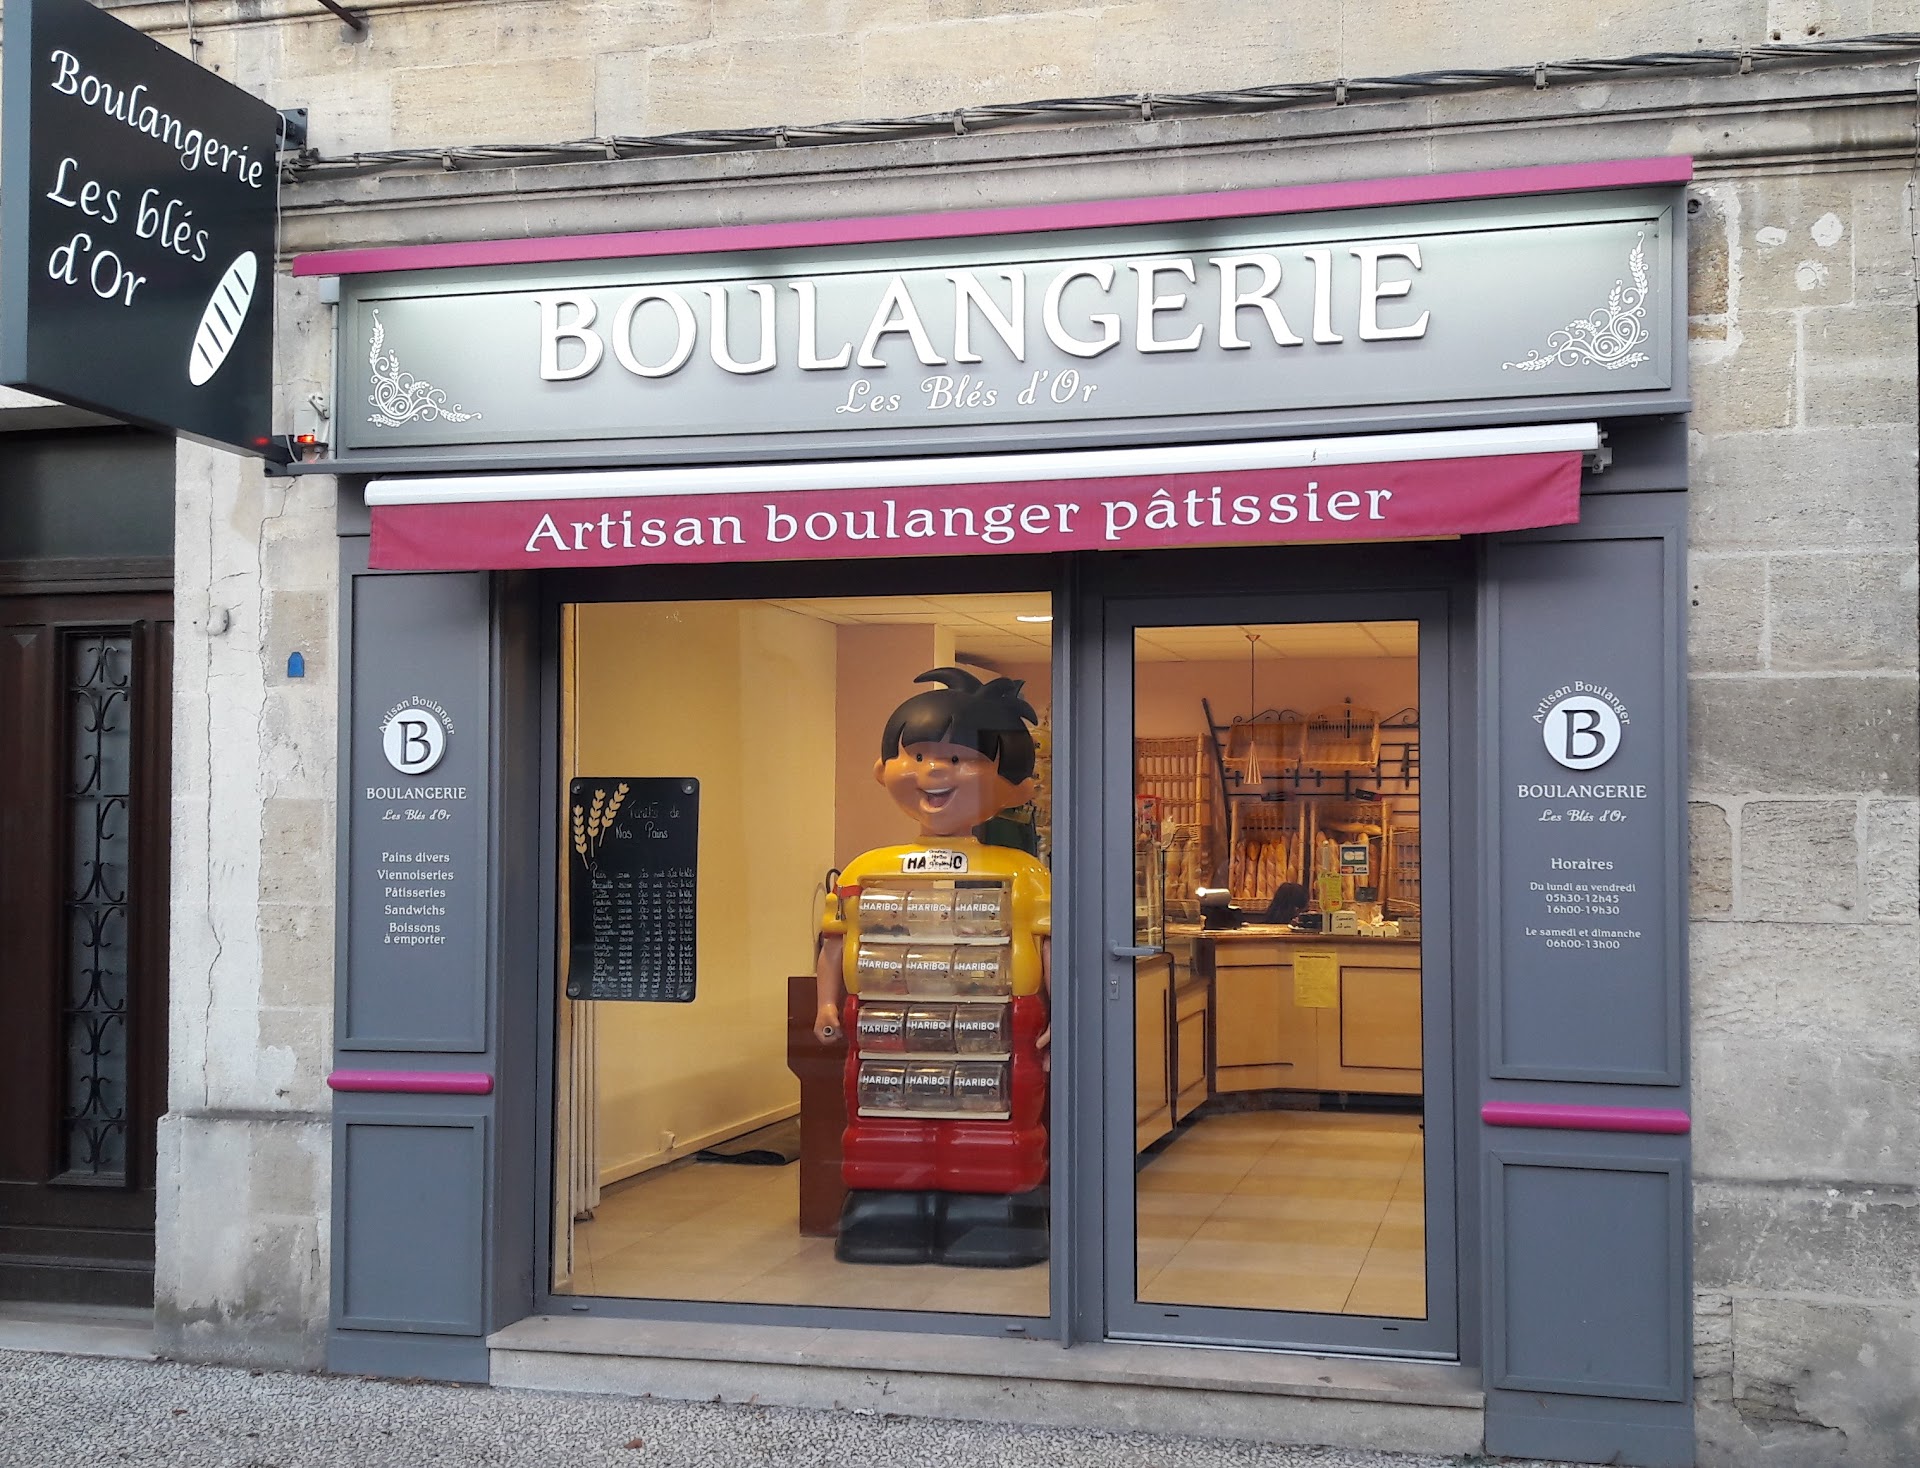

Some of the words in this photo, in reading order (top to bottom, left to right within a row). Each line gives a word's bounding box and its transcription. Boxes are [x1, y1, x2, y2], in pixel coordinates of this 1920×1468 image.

[50, 49, 263, 189] Boulangerie
[46, 157, 121, 225] Les
[135, 187, 210, 263] blés
[48, 232, 146, 307] d'Or
[533, 243, 1431, 382] BOULANGERIE
[835, 379, 902, 414] Les
[920, 374, 998, 410] Blés
[1016, 368, 1099, 405] d'Or
[524, 512, 747, 553] Artisan
[763, 500, 1080, 545] boulanger
[1100, 481, 1393, 541] pâtissier
[1532, 684, 1572, 724] Artisan
[1575, 680, 1631, 725] Boulanger
[379, 699, 410, 734] Artisan
[412, 695, 455, 735] Boulanger
[1562, 709, 1606, 760] B
[397, 721, 431, 765] B
[366, 787, 467, 799] BOULANGERIE
[1517, 784, 1647, 798] BOULANGERIE
[382, 809, 401, 820] Les
[429, 809, 452, 820] d'Or
[1538, 809, 1562, 822] Les
[1567, 809, 1594, 822] Blés
[1599, 809, 1627, 822] d'Or
[616, 823, 633, 839] Nos
[645, 821, 669, 839] Pains
[381, 852, 412, 862] Pains
[415, 852, 450, 862] divers
[1551, 858, 1614, 870] Horaires
[377, 869, 454, 880] Viennoiseries
[1530, 881, 1544, 891] Du
[1546, 882, 1573, 891] lundi
[1575, 884, 1588, 892] au
[1590, 883, 1636, 892] vendredi
[385, 887, 446, 898] Pâtisseries
[1545, 894, 1619, 904] 05h30-12h45
[384, 905, 446, 915] Sandwichs
[863, 902, 899, 911] HARIBO
[911, 904, 947, 912] HARIBO
[960, 903, 996, 912] HARIBO
[1547, 905, 1620, 915] 16h00-19h30
[389, 922, 441, 933] Boissons
[1525, 927, 1537, 936] Le
[1539, 928, 1577, 937] samedi
[1578, 929, 1589, 937] et
[1591, 929, 1641, 938] dimanche
[384, 933, 391, 944] à
[393, 934, 446, 946] emporter
[1546, 939, 1620, 949] 06h00-13h00
[862, 960, 898, 970] HARIBO
[910, 962, 946, 971] HARIBO
[959, 962, 994, 971] HARIBO
[861, 1024, 897, 1033] HARIBO
[911, 1021, 947, 1030] HARIBO
[959, 1022, 995, 1031] HARIBO
[862, 1075, 898, 1085] HARIBO
[910, 1076, 945, 1085] HARIBO
[959, 1078, 994, 1087] HARIBO
